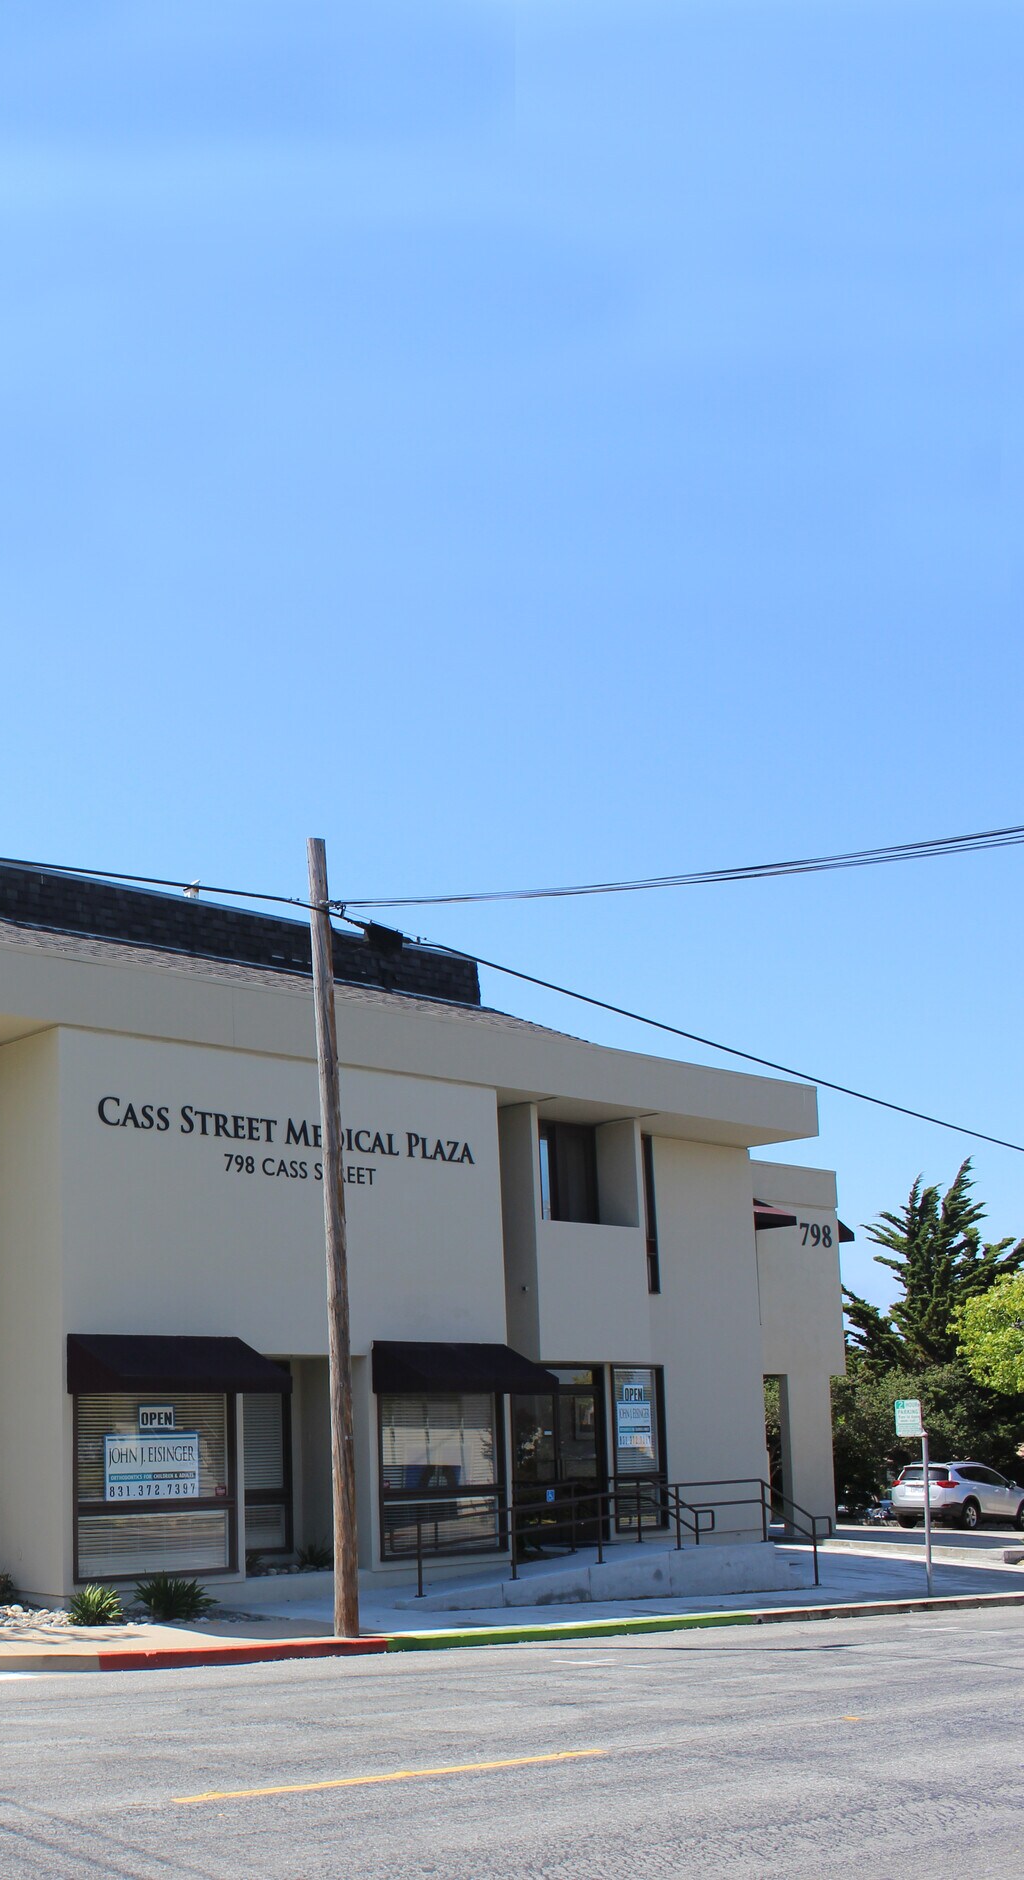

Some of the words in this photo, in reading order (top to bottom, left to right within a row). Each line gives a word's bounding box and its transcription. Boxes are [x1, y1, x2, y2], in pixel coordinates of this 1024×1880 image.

[285, 1118, 399, 1156] MEICAL
[224, 1153, 255, 1174] 798
[262, 1158, 308, 1179] CASS
[314, 1163, 376, 1185] SEET
[799, 1222, 833, 1248] 798
[624, 1388, 643, 1401] OPEN
[898, 1401, 904, 1409] 2
[141, 1411, 173, 1426] OPEN
[108, 1447, 138, 1468] JOHN
[140, 1447, 146, 1467] J.
[148, 1445, 195, 1463] EISINGER
[109, 1483, 196, 1497] 831.372.7397
